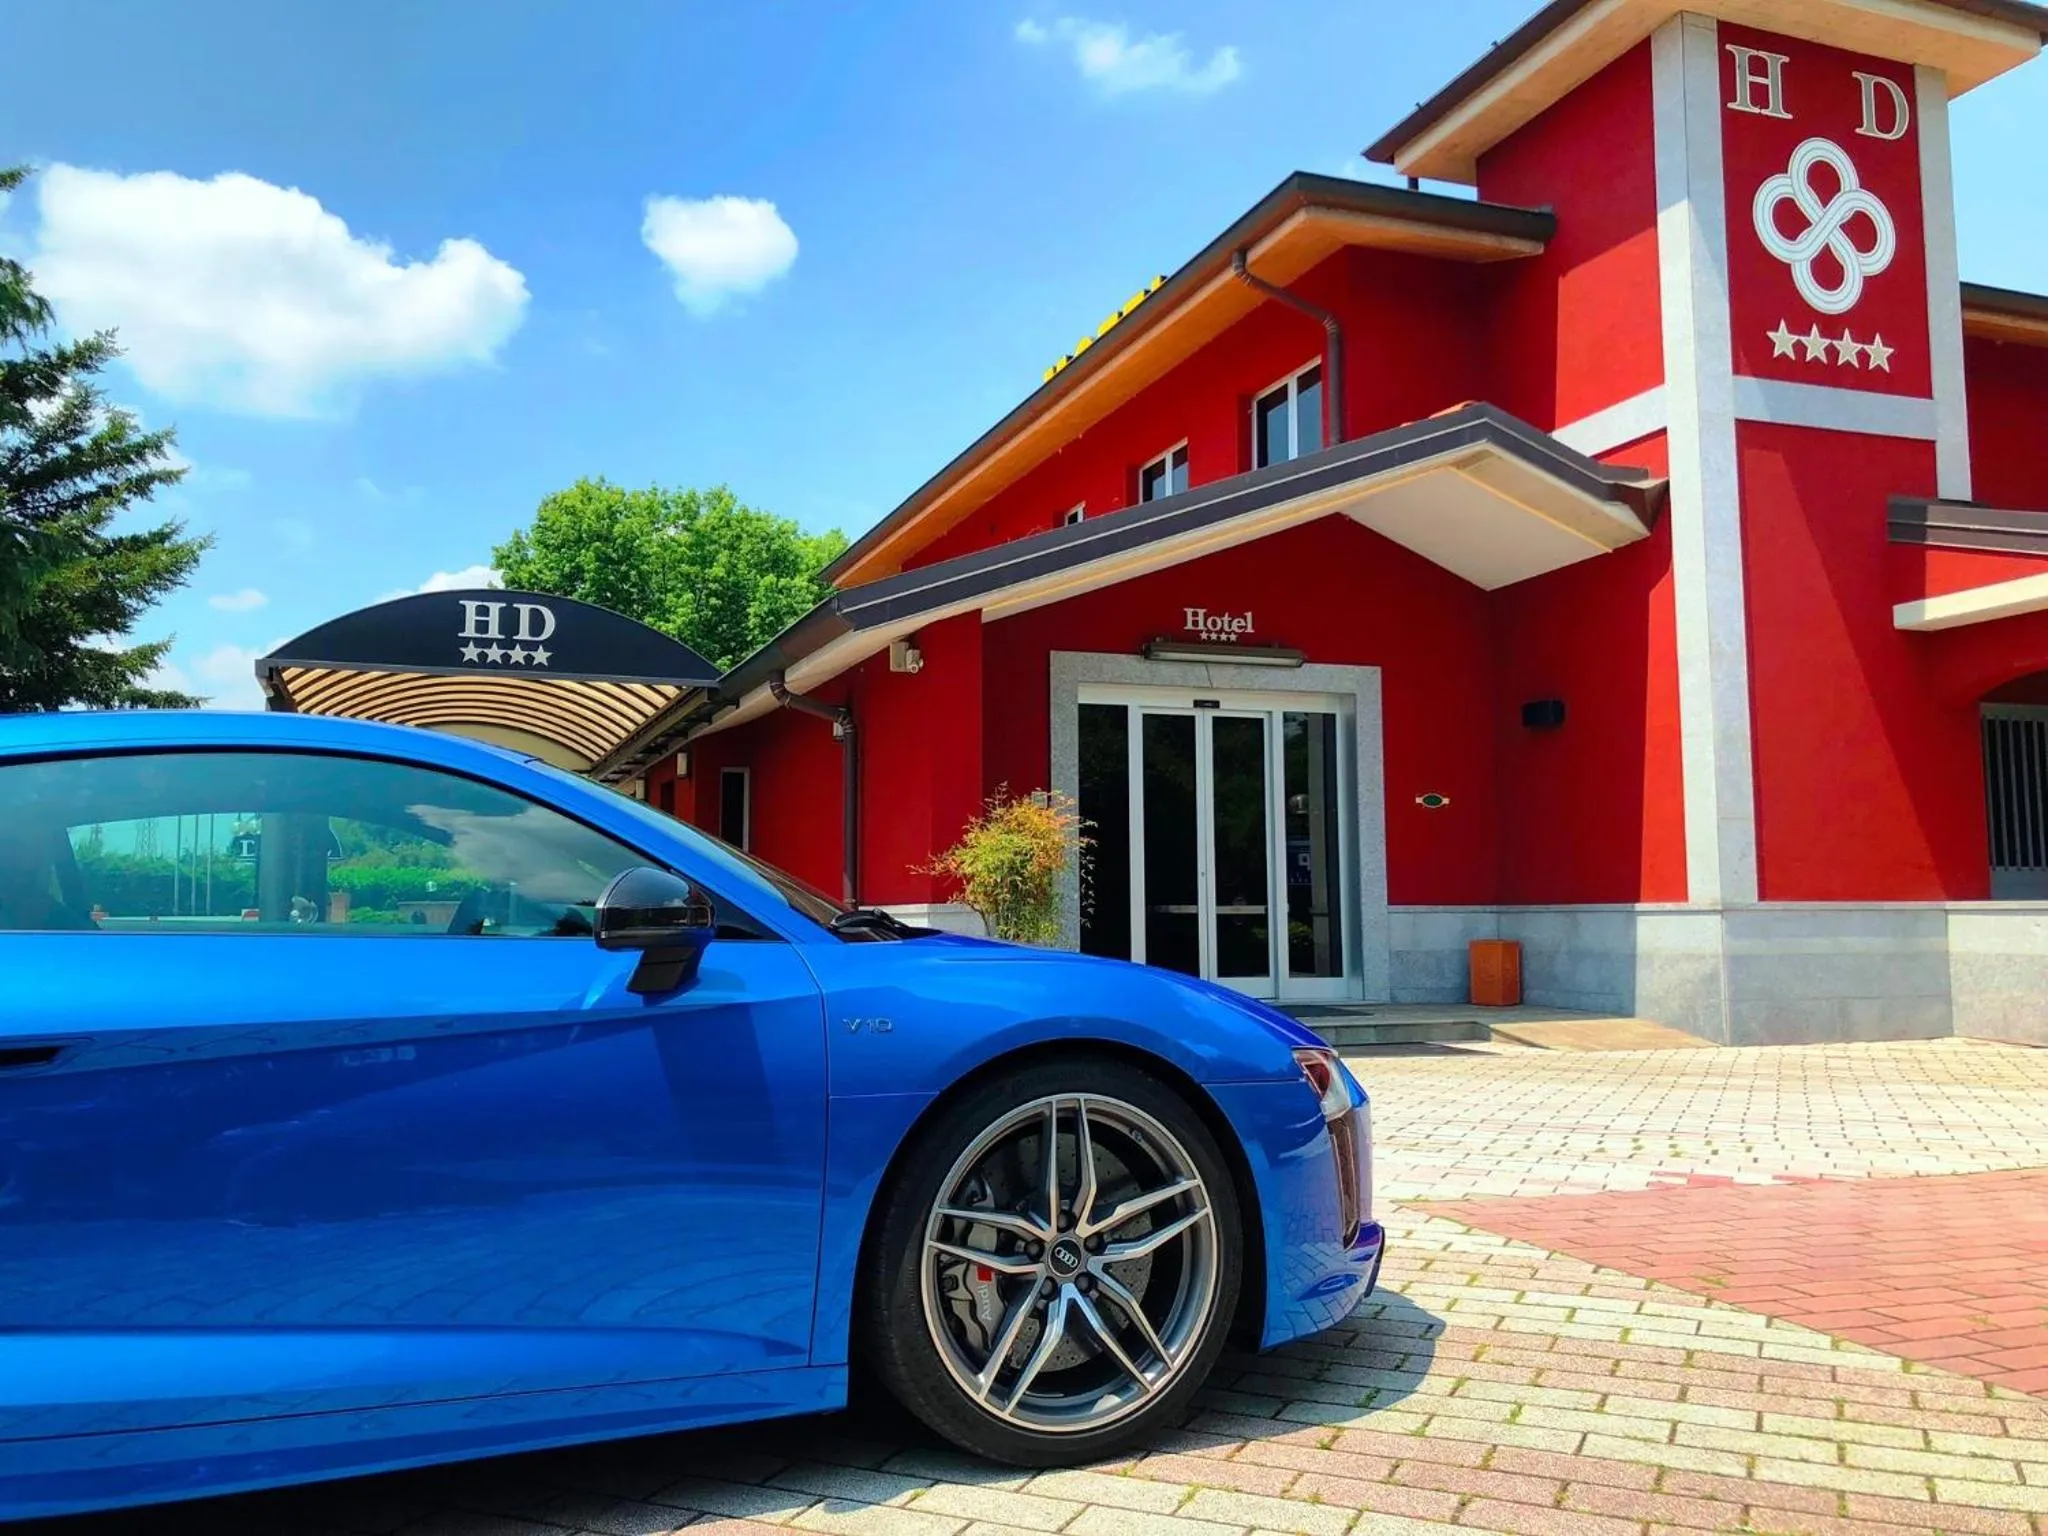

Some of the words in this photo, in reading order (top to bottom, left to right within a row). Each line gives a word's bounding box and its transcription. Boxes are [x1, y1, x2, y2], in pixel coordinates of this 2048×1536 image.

[1183, 608, 1255, 633] Hotel
[842, 1017, 893, 1033] V10
[978, 1284, 992, 1321] Audi
